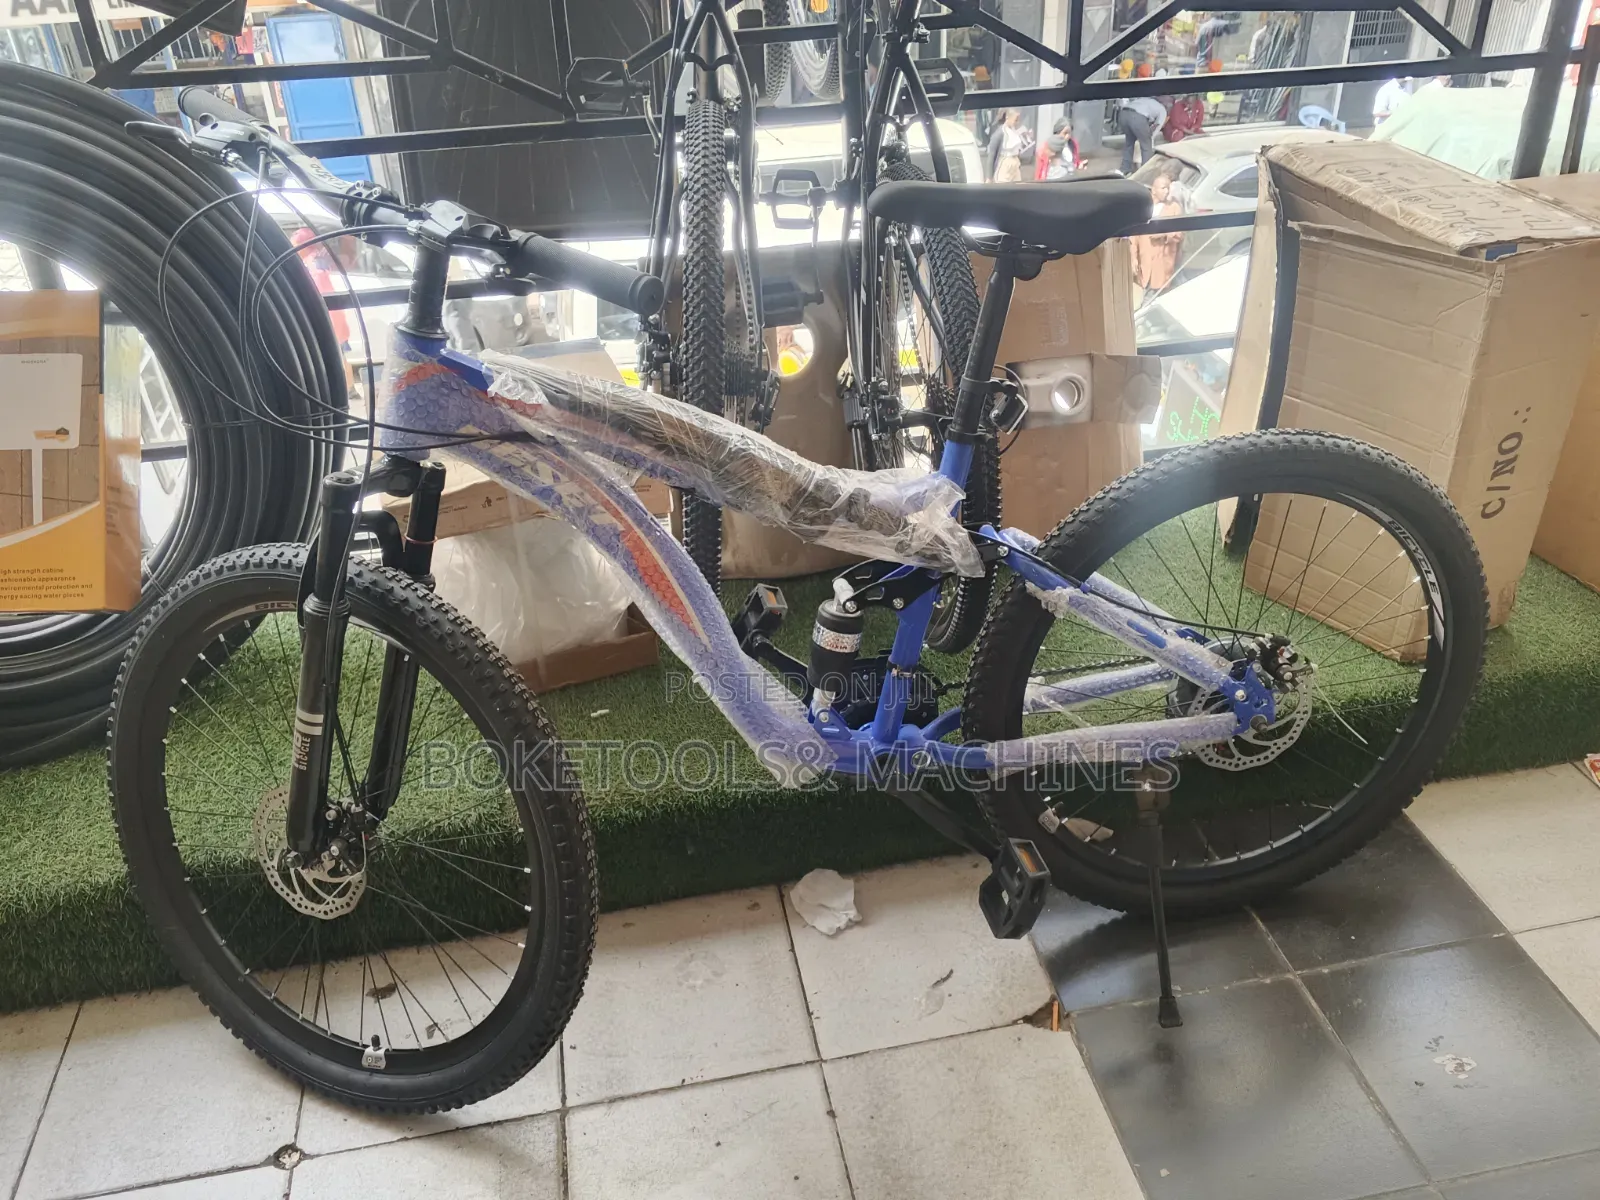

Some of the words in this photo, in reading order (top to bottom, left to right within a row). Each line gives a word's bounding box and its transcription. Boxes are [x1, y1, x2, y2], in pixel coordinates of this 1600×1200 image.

[1387, 520, 1440, 595] BICYCLE
[13, 567, 41, 575] strength
[38, 575, 76, 583] appearance
[45, 584, 80, 592] protection
